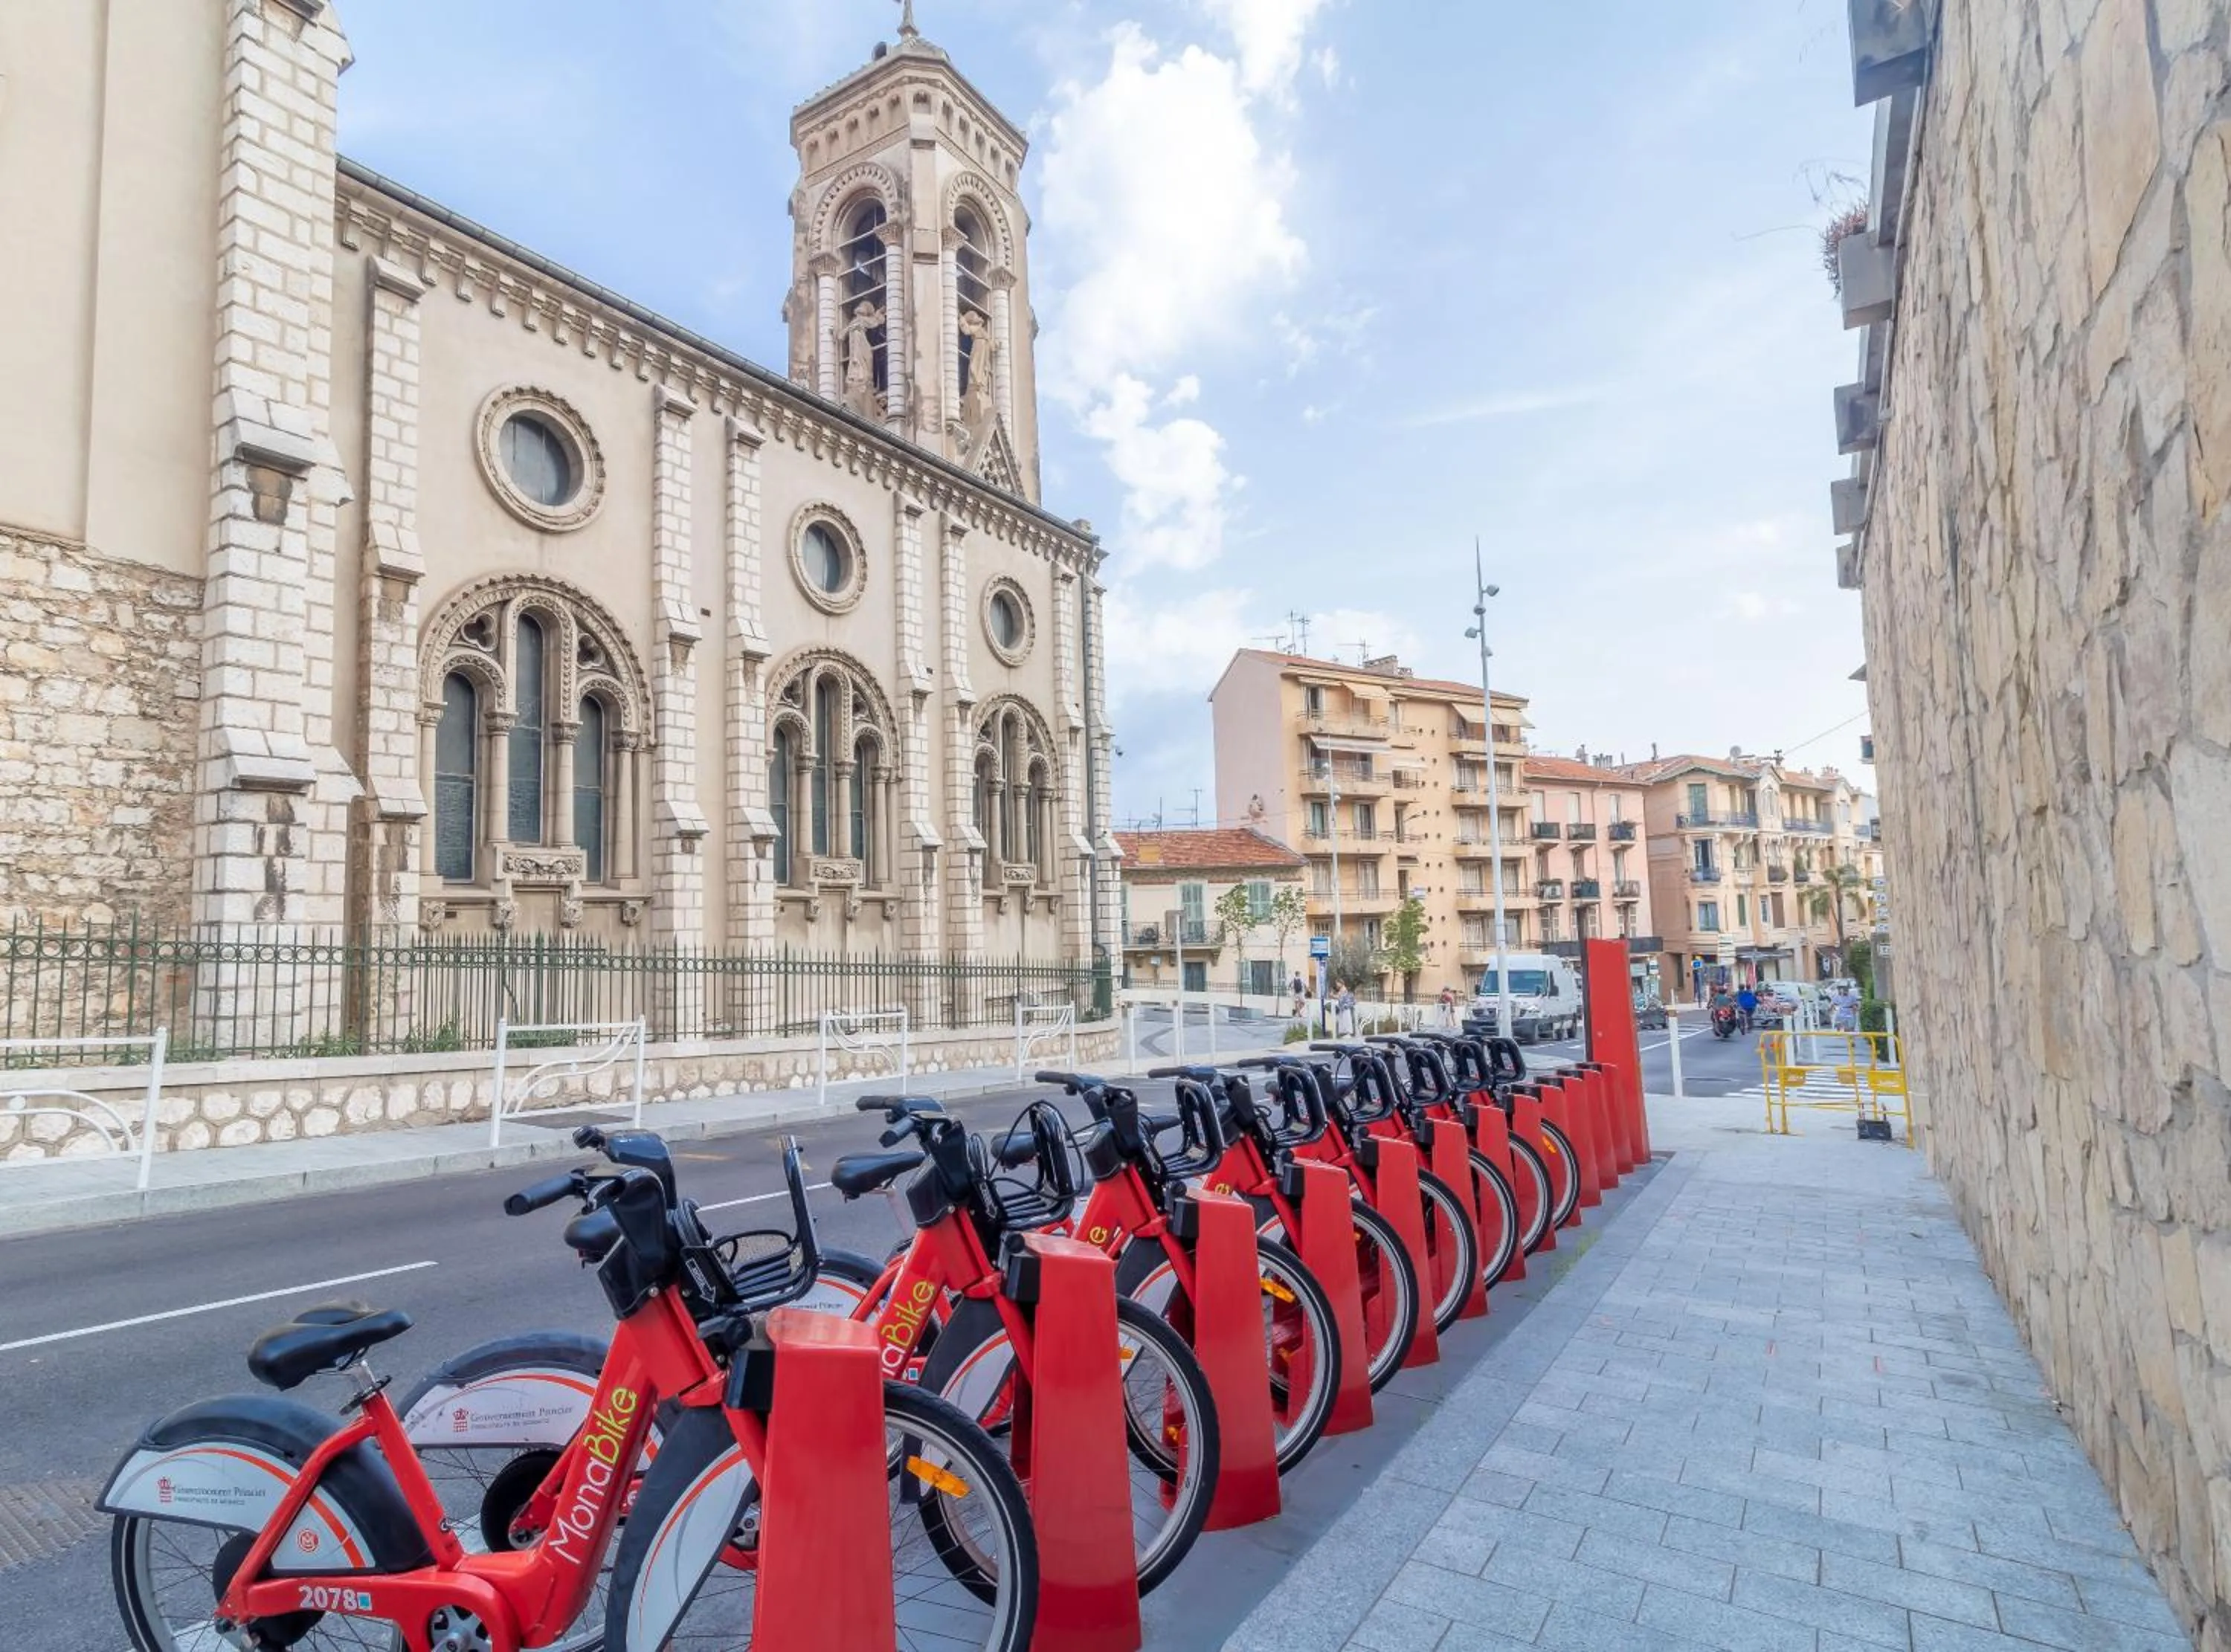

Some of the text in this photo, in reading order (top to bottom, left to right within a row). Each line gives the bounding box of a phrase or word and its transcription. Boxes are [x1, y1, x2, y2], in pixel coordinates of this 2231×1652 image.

[880, 1281, 935, 1376] aBike
[549, 1387, 637, 1564] MonaBike
[298, 1584, 358, 1611] 2078
